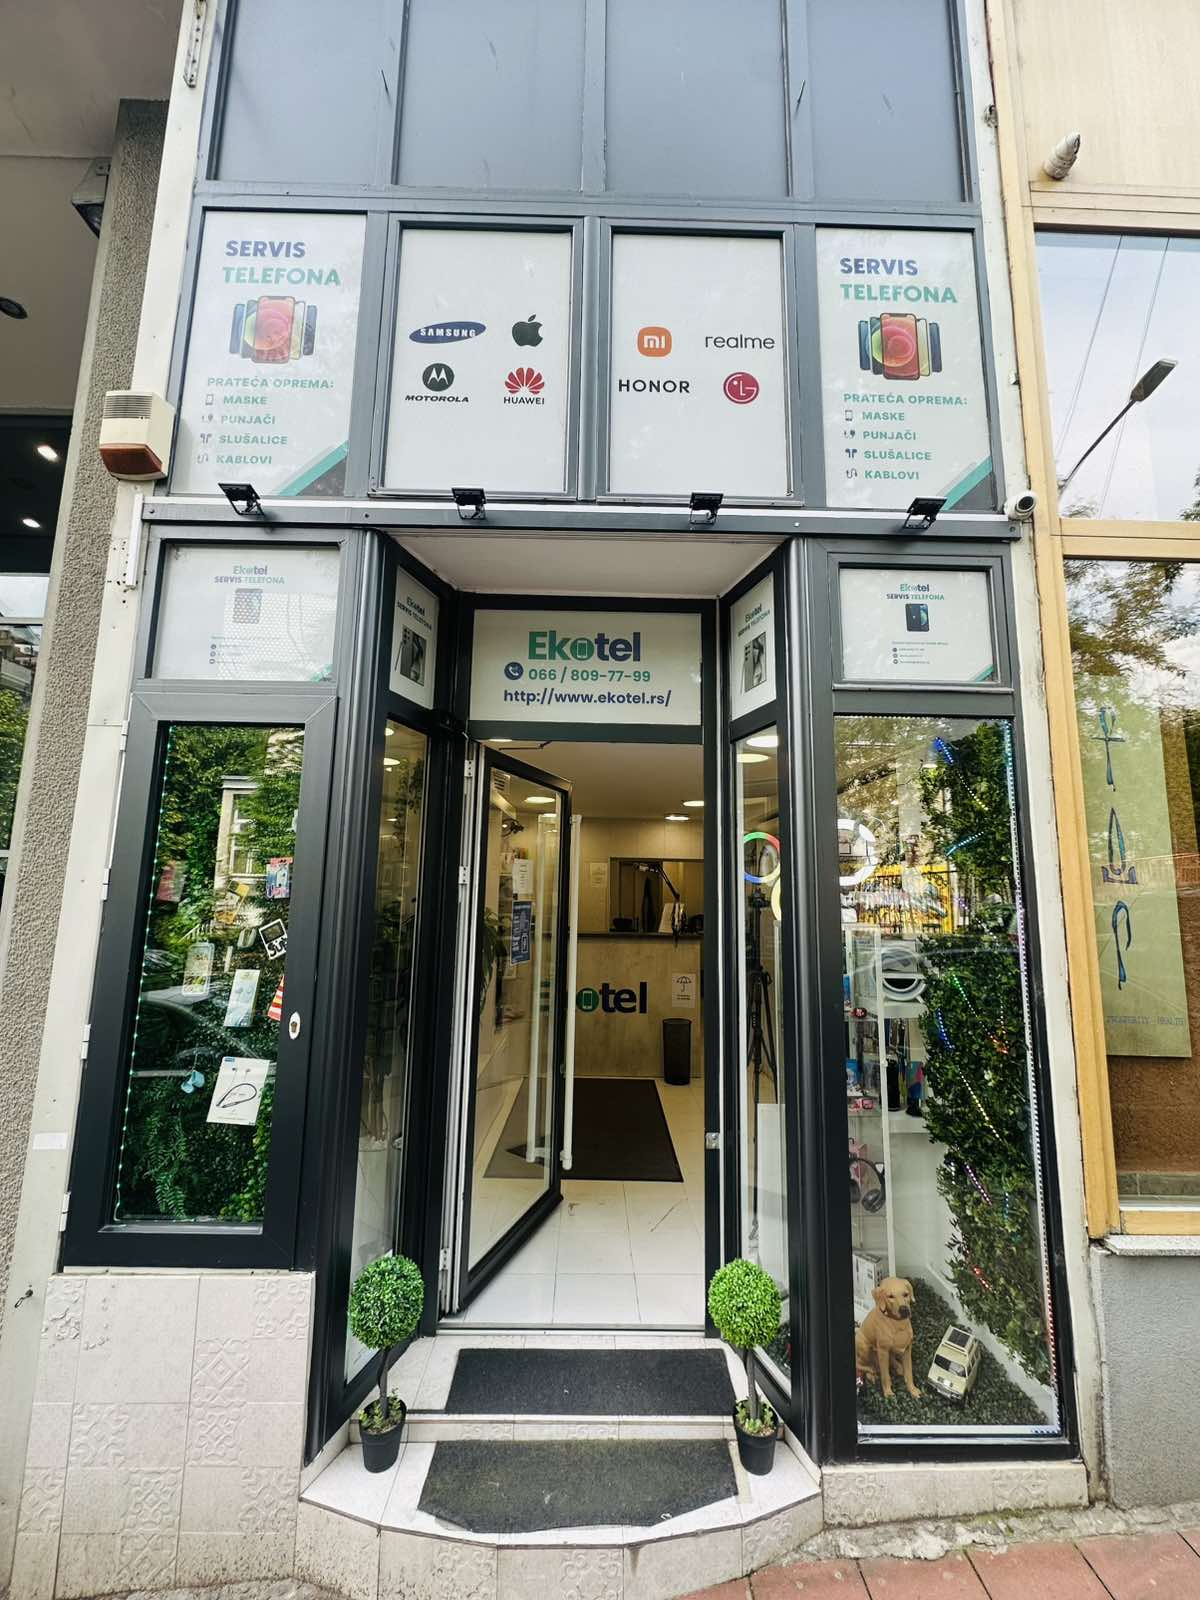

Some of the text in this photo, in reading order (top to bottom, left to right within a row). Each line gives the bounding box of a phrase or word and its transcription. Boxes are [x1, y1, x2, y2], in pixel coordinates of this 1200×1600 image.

[225, 240, 306, 258] SERVIS
[839, 257, 919, 277] SERVIS
[222, 266, 342, 286] TELEFONA
[839, 284, 958, 303] TELEFONA
[419, 328, 477, 338] SAMSUNG
[705, 334, 775, 349] realme
[273, 378, 335, 389] OPREMA:
[618, 379, 690, 393] HONOR
[223, 395, 268, 405] MASKE
[405, 394, 469, 403] MOTOROLA
[503, 396, 545, 405] HUAWEI
[907, 395, 968, 405] OPREMA:
[220, 413, 276, 425] PUNJAČI
[862, 411, 905, 421] MASKE
[218, 433, 288, 445] SLUŠALICE
[863, 429, 917, 440] PUNJAČI
[216, 455, 273, 464] KABLOVI
[863, 448, 933, 460] SLUŠALICE
[864, 470, 920, 480] KABLOVI
[528, 631, 641, 662] Ekotel
[528, 668, 557, 681] 066
[571, 669, 651, 683] 809-77-99
[504, 688, 672, 707] http://www.ekotel.rs/
